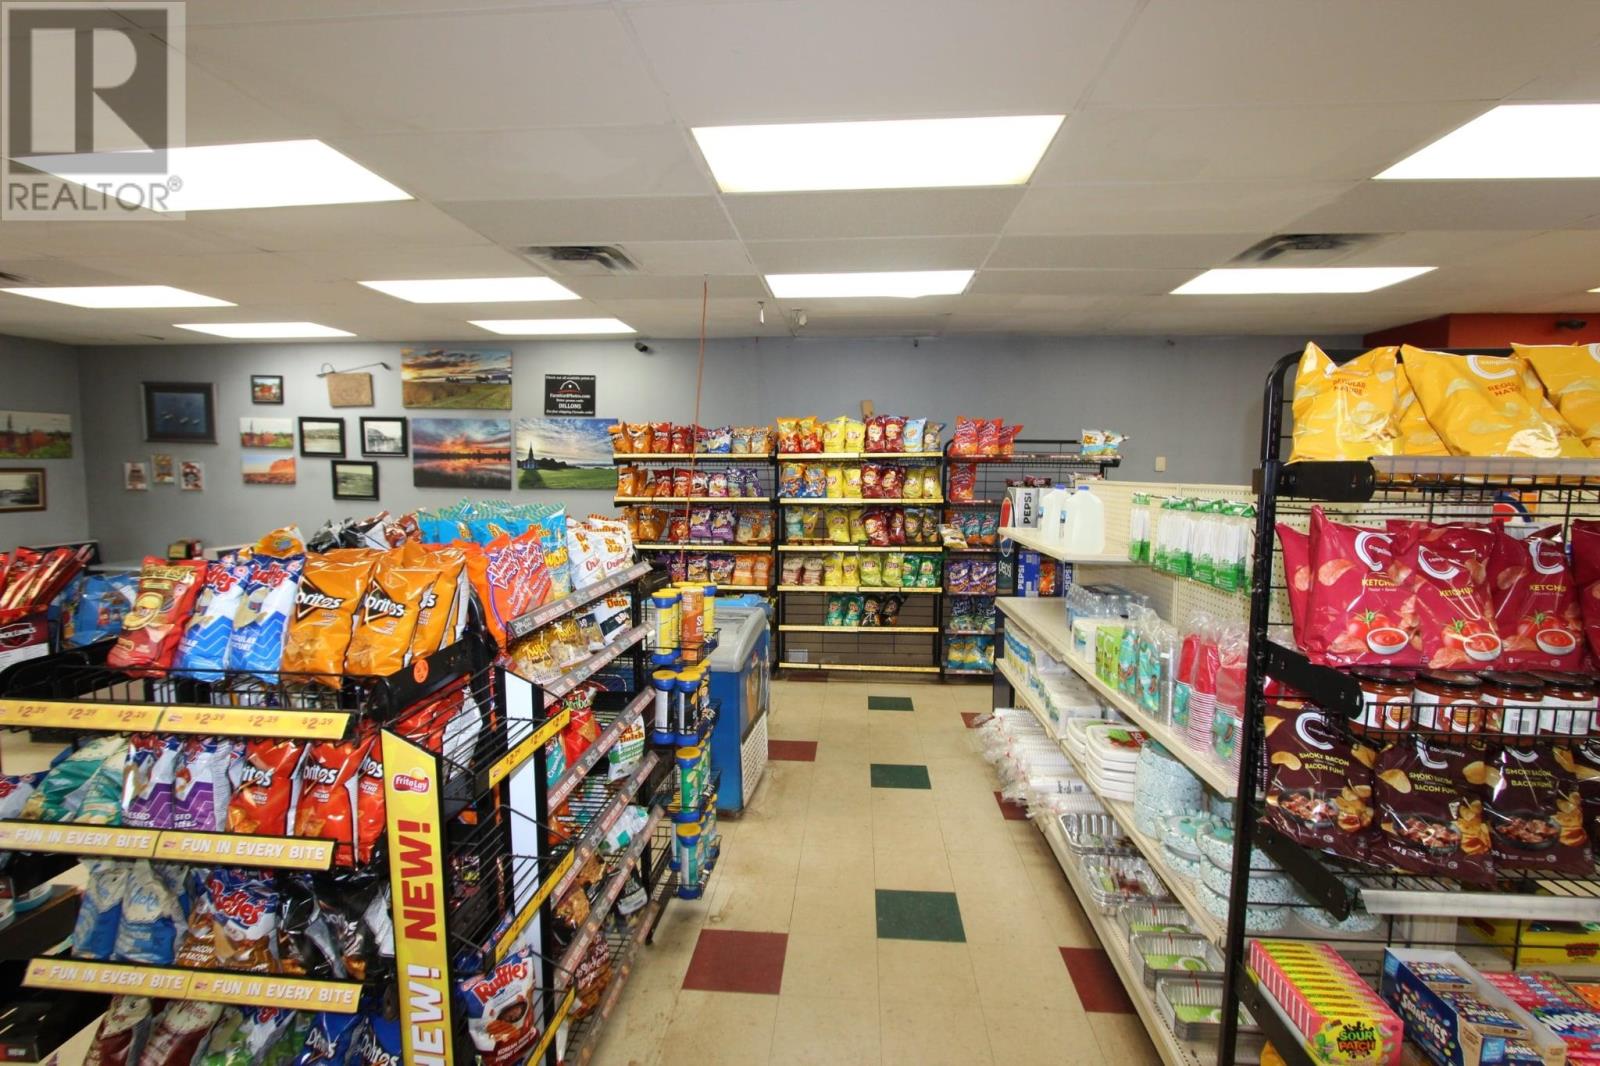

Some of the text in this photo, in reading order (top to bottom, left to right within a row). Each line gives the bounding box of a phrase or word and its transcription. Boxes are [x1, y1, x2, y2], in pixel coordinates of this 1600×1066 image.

[1023, 492, 1032, 525] PEPSI
[15, 829, 151, 849] FUN IN EVERY BITE
[180, 837, 325, 860] FUN IN EVERY BITE
[397, 819, 438, 942] NEW!
[49, 967, 185, 989] FUN IN EVERY BITE
[471, 962, 529, 1005] Ruffles
[212, 979, 353, 1004] FUN IN EVERY BITE
[407, 963, 447, 1066] EW!
[1338, 1040, 1376, 1051] PATCH
[1340, 1031, 1375, 1041] SOUR
